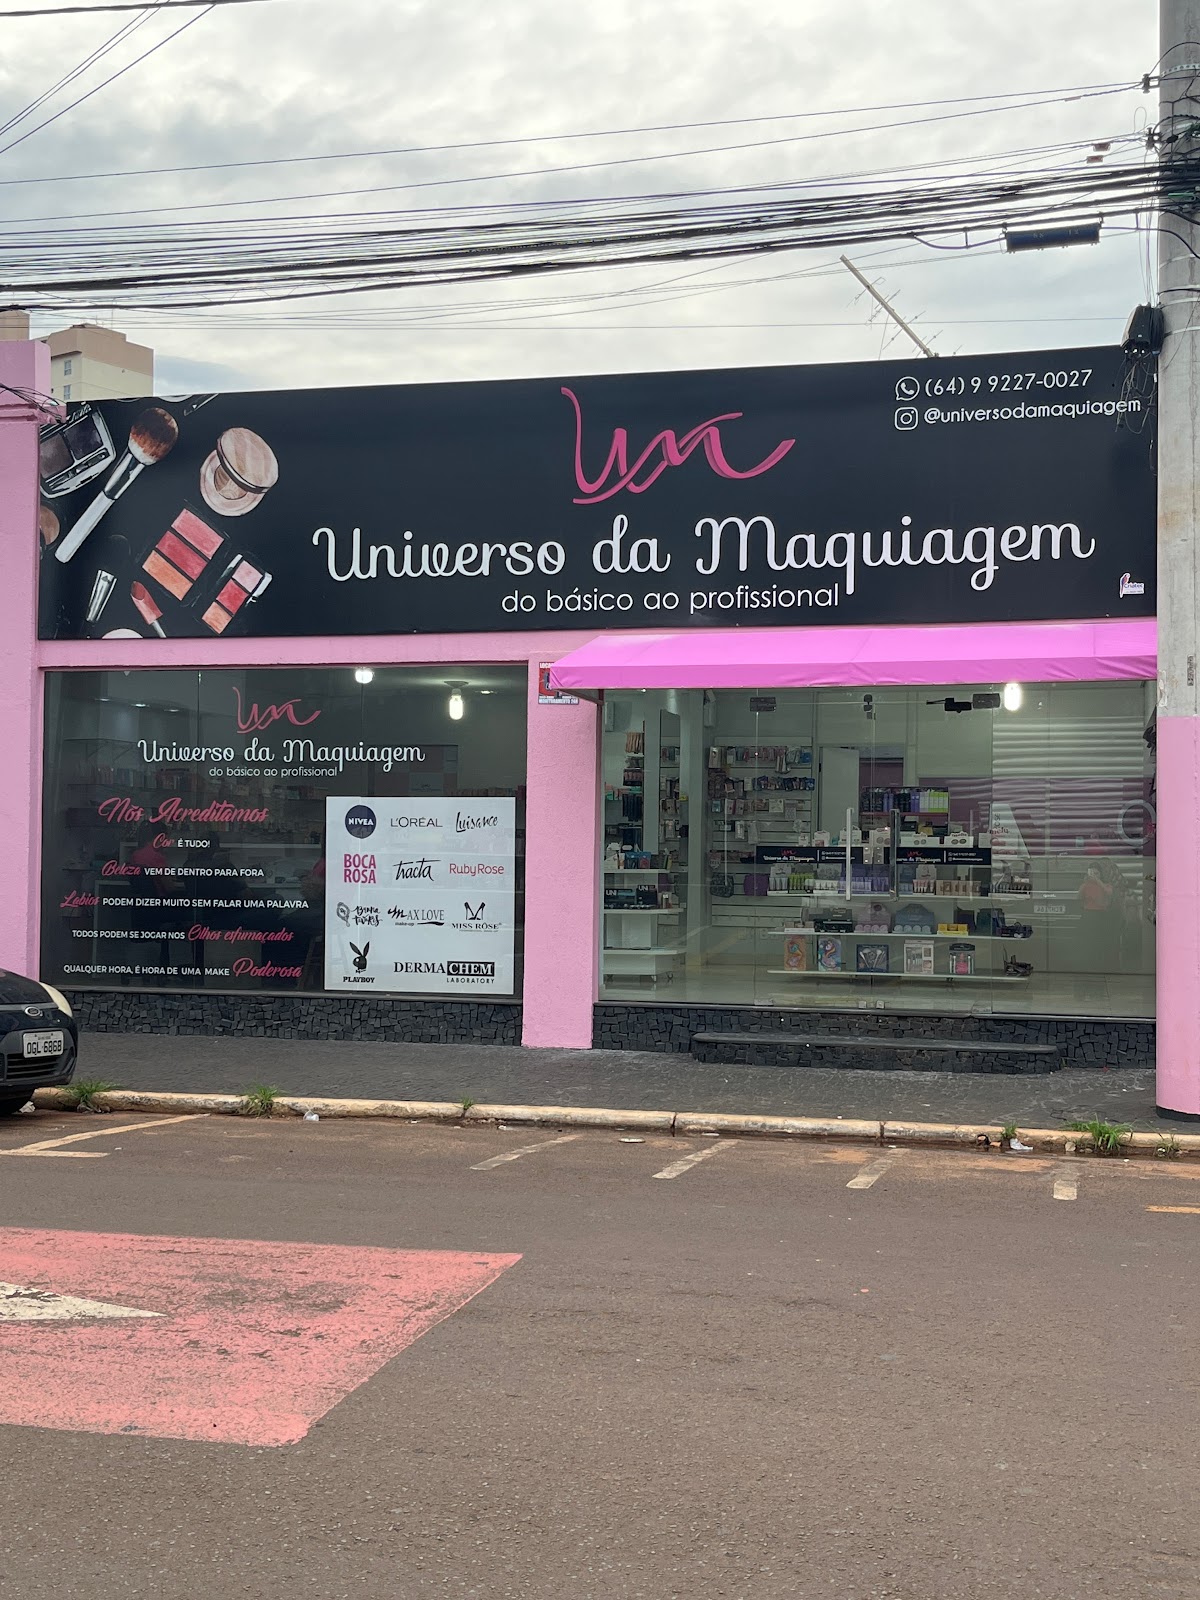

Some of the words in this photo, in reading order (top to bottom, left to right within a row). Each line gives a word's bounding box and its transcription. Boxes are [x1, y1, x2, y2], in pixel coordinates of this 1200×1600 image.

[925, 375, 965, 397] (64)
[971, 376, 982, 395] 9
[988, 368, 1093, 393] 9227-0027
[924, 398, 1141, 424] @universodamaquiagem
[312, 528, 566, 582] Universo
[593, 514, 672, 576] da
[694, 515, 1096, 594] Maquiagem
[501, 589, 536, 612] do
[546, 585, 634, 613] básico
[643, 592, 680, 610] ao
[690, 582, 840, 615] profissional
[137, 739, 235, 763] Universo
[244, 737, 275, 762] da
[282, 738, 426, 772] Maquiagem
[208, 766, 223, 777] do
[226, 765, 261, 777] básico
[263, 768, 278, 777] ao
[280, 765, 338, 779] profissional
[150, 797, 269, 823] Acreditamos
[348, 817, 374, 826] NIVEA
[455, 811, 499, 833] Luisance
[153, 832, 175, 849] Cor
[177, 837, 184, 848] É
[185, 839, 211, 848] TUDO!
[102, 860, 141, 877] Beleza
[144, 867, 163, 876] VEM
[164, 867, 176, 876] DE
[177, 867, 213, 877] DENTRO
[214, 868, 238, 877] PARA
[239, 868, 265, 877] FORA
[344, 853, 377, 869] BOCA
[344, 868, 377, 884] ROSA
[102, 897, 134, 906] PODEM
[135, 898, 161, 907] DIZER
[162, 898, 191, 907] MUITO
[192, 899, 211, 907] SEM
[213, 899, 242, 908] FALAR
[243, 899, 265, 908] UMA
[266, 899, 309, 909] PALAVRA
[421, 909, 445, 921] LOVE
[71, 929, 98, 938] TODOS
[99, 930, 128, 939] PODEM
[129, 931, 140, 939] SE
[140, 931, 167, 940] JOGAR
[168, 931, 186, 940] NOS
[188, 924, 222, 942] Olhos
[223, 926, 294, 944] esfumaçados
[451, 922, 473, 930] MISS
[63, 964, 107, 974] QUALQUER
[141, 966, 166, 975] HORA
[166, 967, 178, 975] DE
[181, 967, 201, 976] UMA
[204, 967, 230, 976] MAKE
[232, 957, 303, 978] Poderosa
[393, 961, 446, 974] DERMA
[448, 962, 494, 975] CHEM
[342, 976, 375, 984] PLAYBOY
